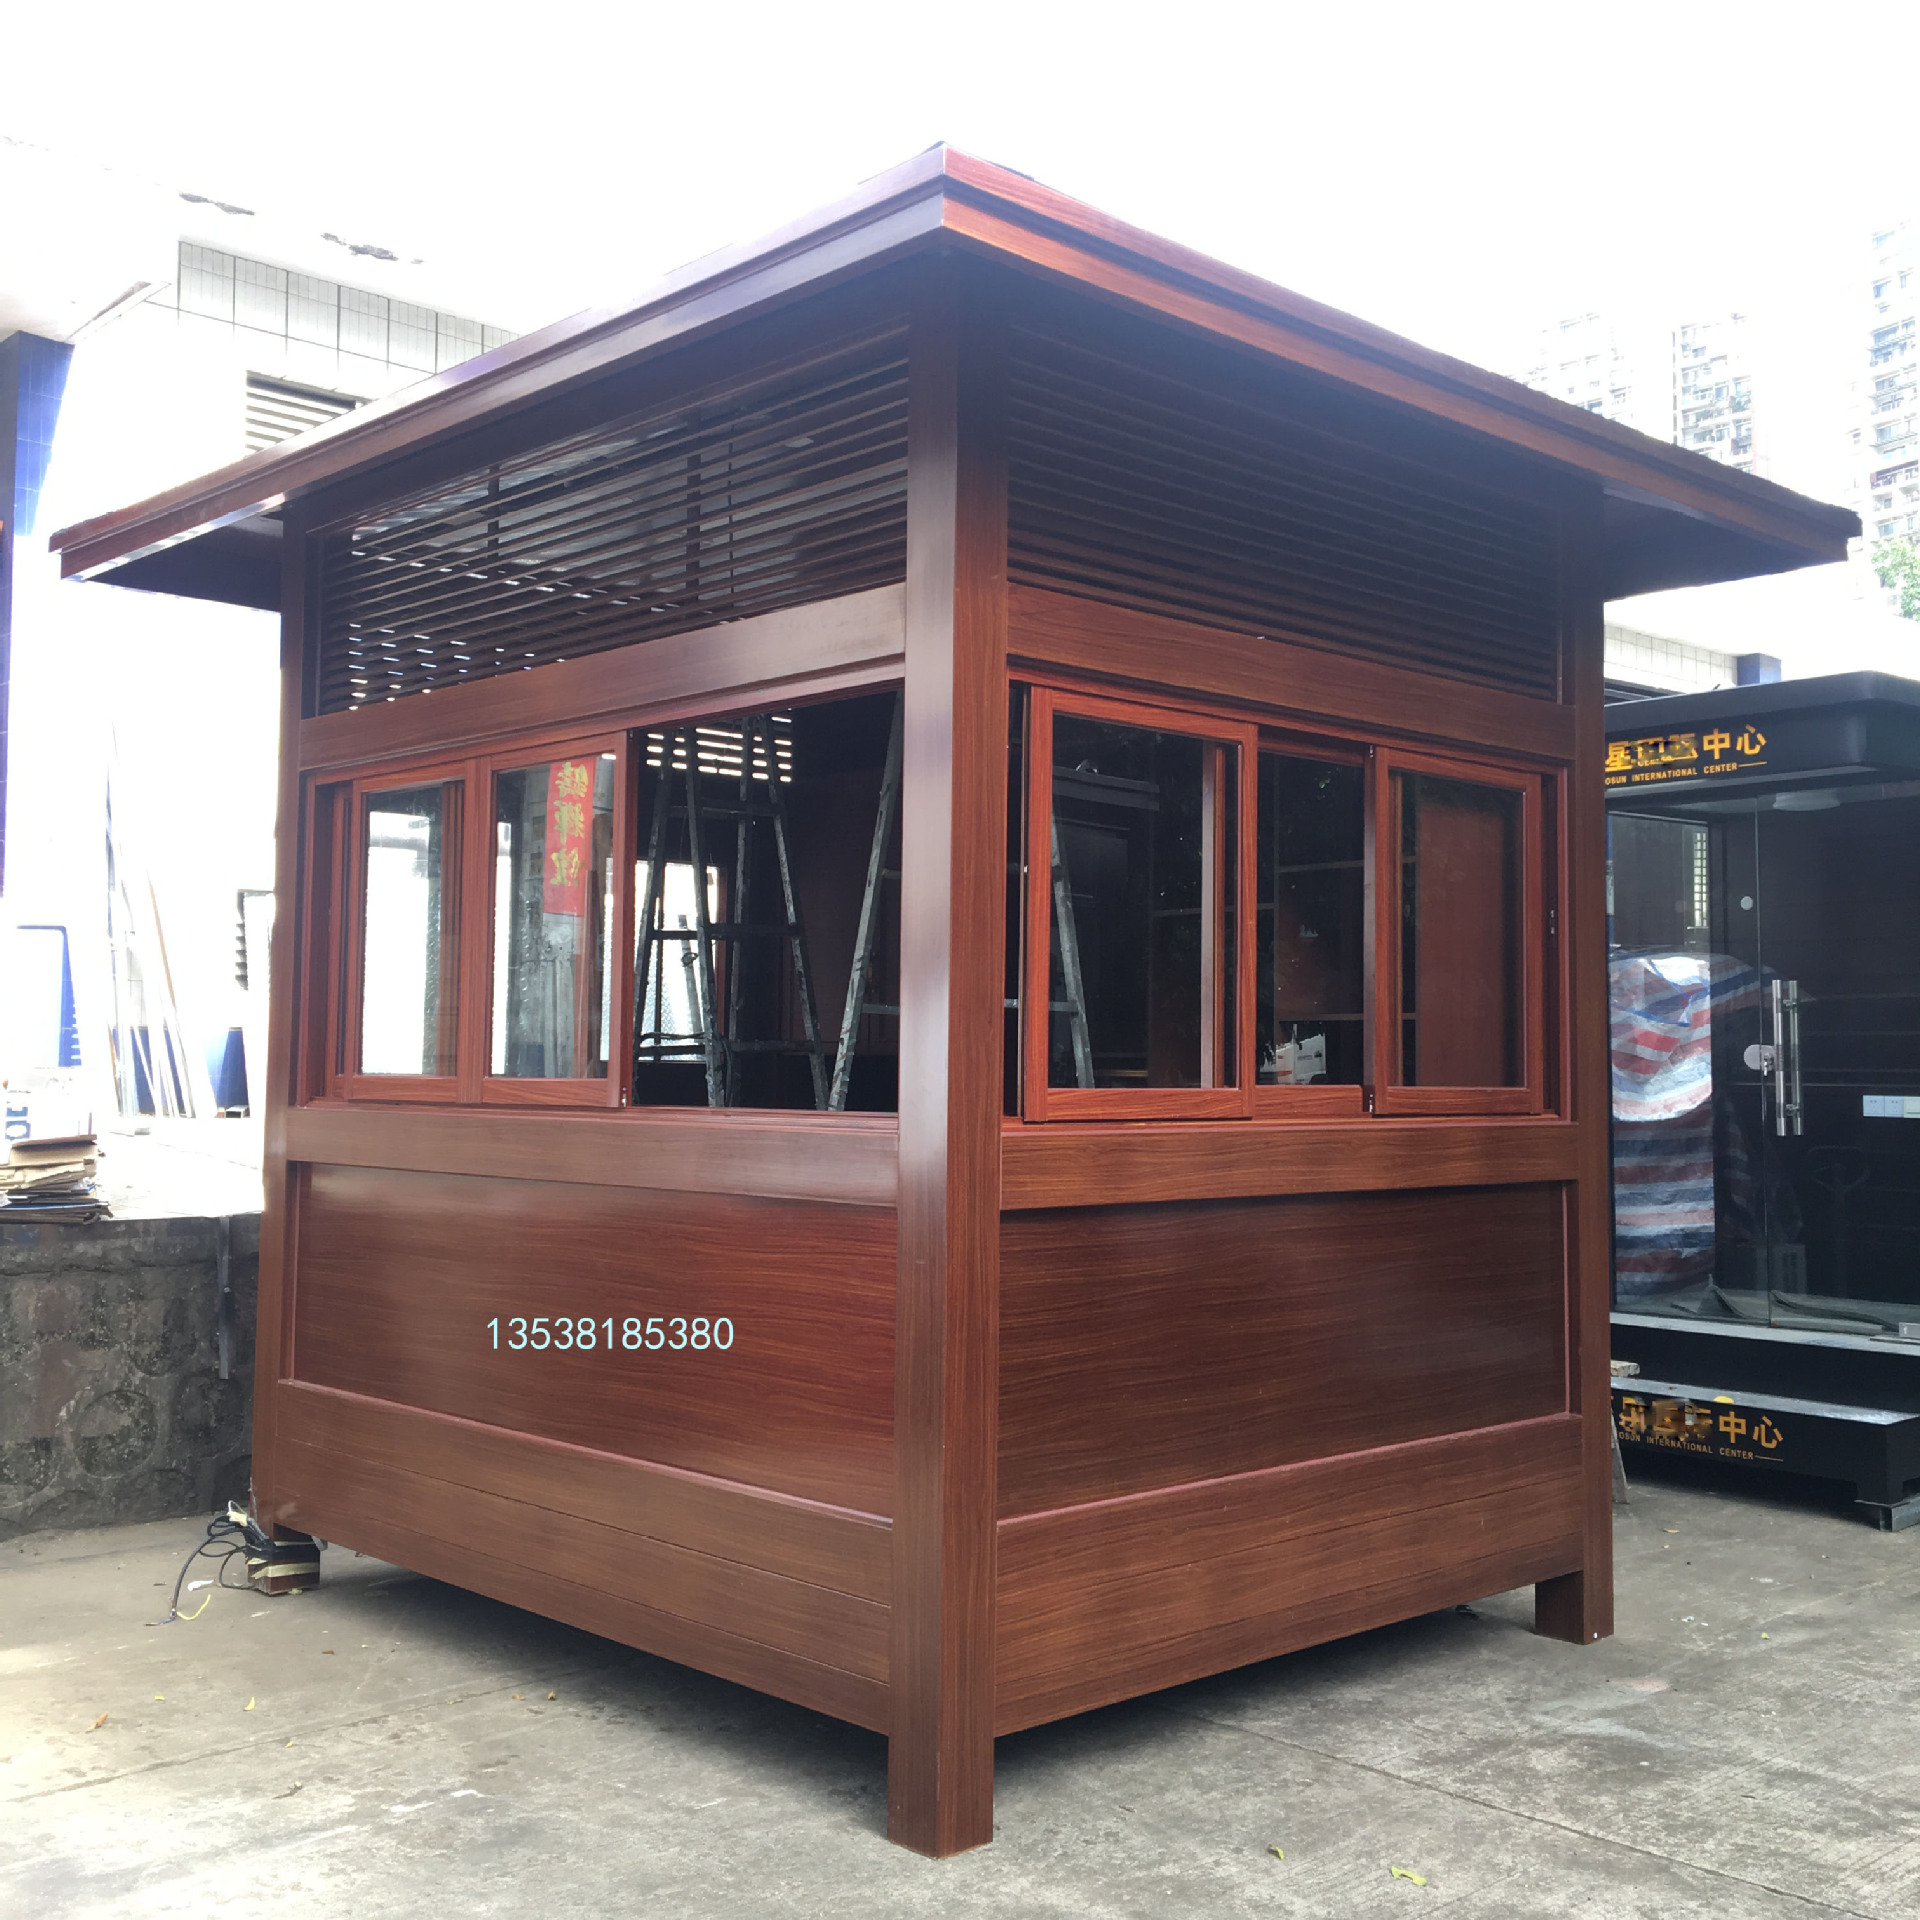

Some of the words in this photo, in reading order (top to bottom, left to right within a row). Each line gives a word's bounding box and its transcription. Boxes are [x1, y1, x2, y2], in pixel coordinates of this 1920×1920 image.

[1632, 767, 1698, 782] INTERNATIONAL
[1703, 762, 1738, 774] CENTER
[1646, 1435, 1713, 1454] INTERNATIONAL
[1719, 1446, 1754, 1460] CENTER
